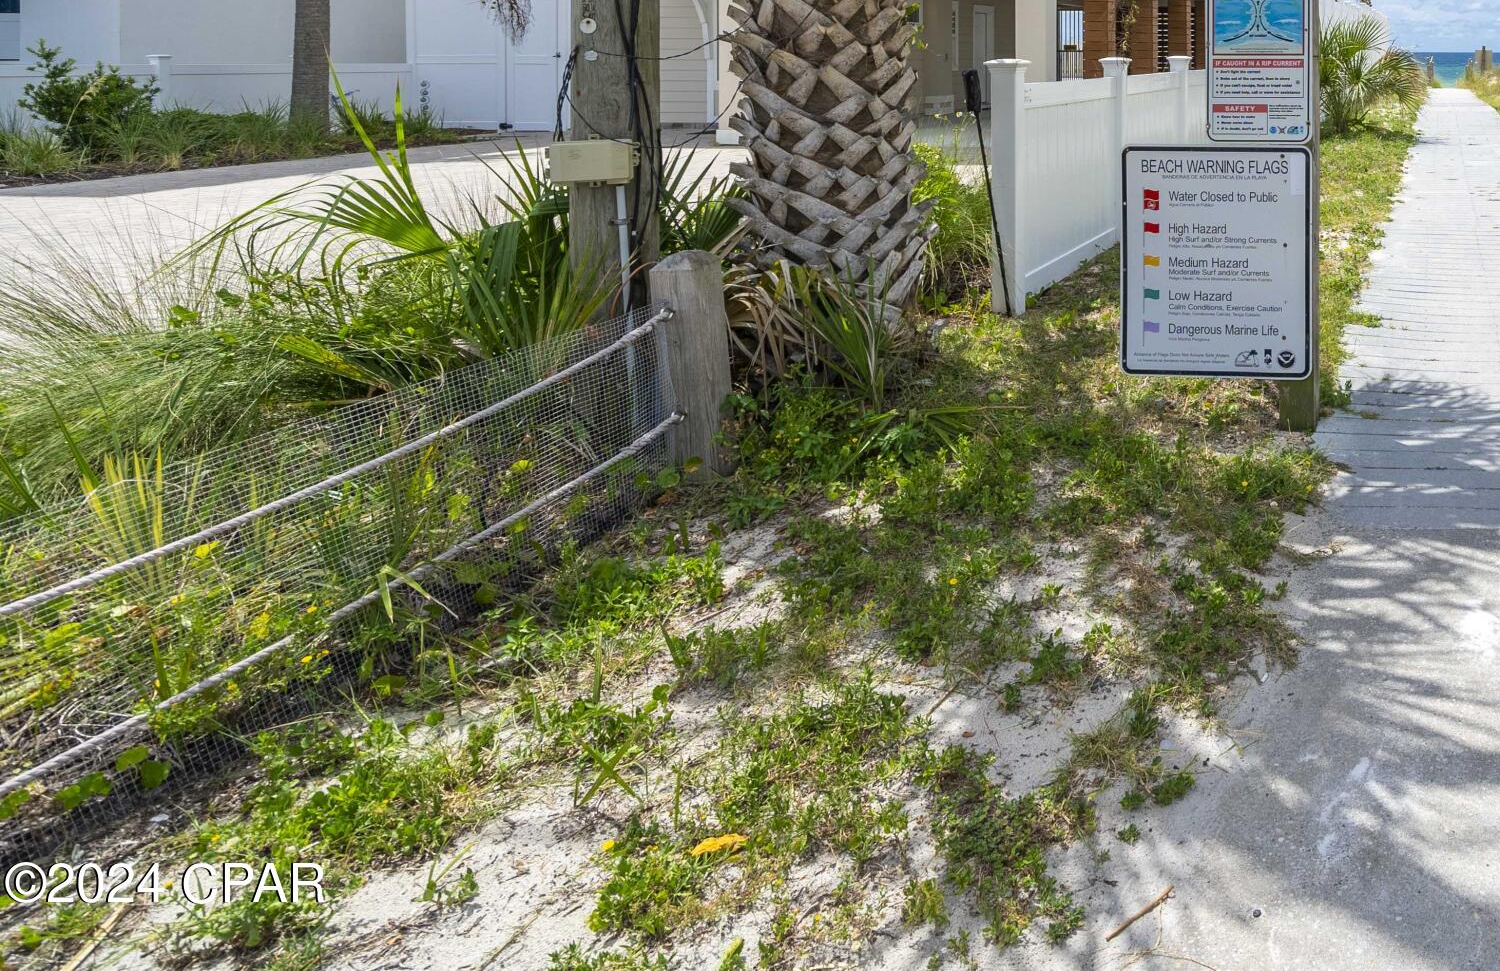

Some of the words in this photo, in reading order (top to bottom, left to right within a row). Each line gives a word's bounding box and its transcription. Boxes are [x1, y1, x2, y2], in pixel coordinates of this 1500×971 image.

[1141, 159, 1183, 173] BEACH
[1187, 160, 1244, 174] WARNING
[1248, 160, 1288, 174] FLAGS
[1169, 191, 1197, 202] Water
[1200, 191, 1234, 202] Closed
[1237, 192, 1246, 202] to
[1250, 192, 1278, 203] Public
[1169, 223, 1189, 237] High
[1193, 223, 1227, 234] Hazard
[1169, 257, 1208, 268] Medium
[1212, 258, 1248, 268] Hazard
[1169, 290, 1190, 301] Low
[1194, 290, 1232, 301] Hazard
[1169, 323, 1222, 337] Dangerous
[1225, 324, 1258, 335] Marine
[1261, 325, 1279, 336] Life
